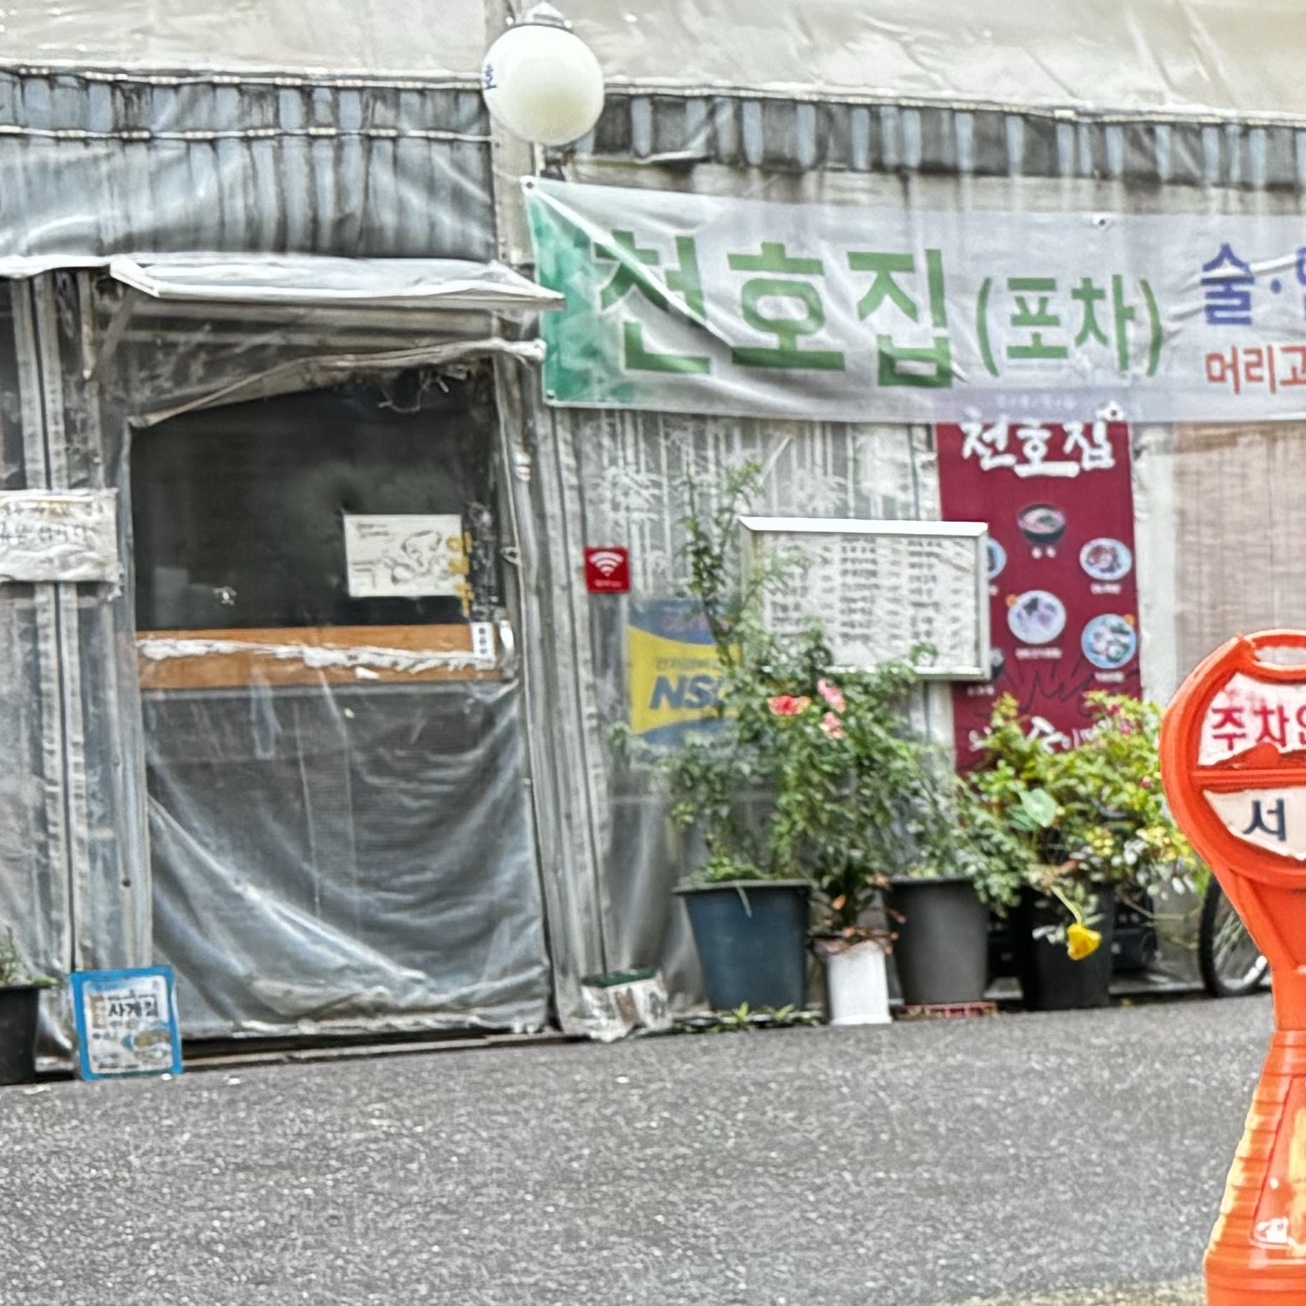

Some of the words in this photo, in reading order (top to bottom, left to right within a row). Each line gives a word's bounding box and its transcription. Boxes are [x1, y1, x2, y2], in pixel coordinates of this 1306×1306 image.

[593, 228, 953, 388] 천호집
[976, 273, 1163, 378] (포차)
[958, 406, 1116, 479] 천호집
[649, 674, 727, 710] NS
